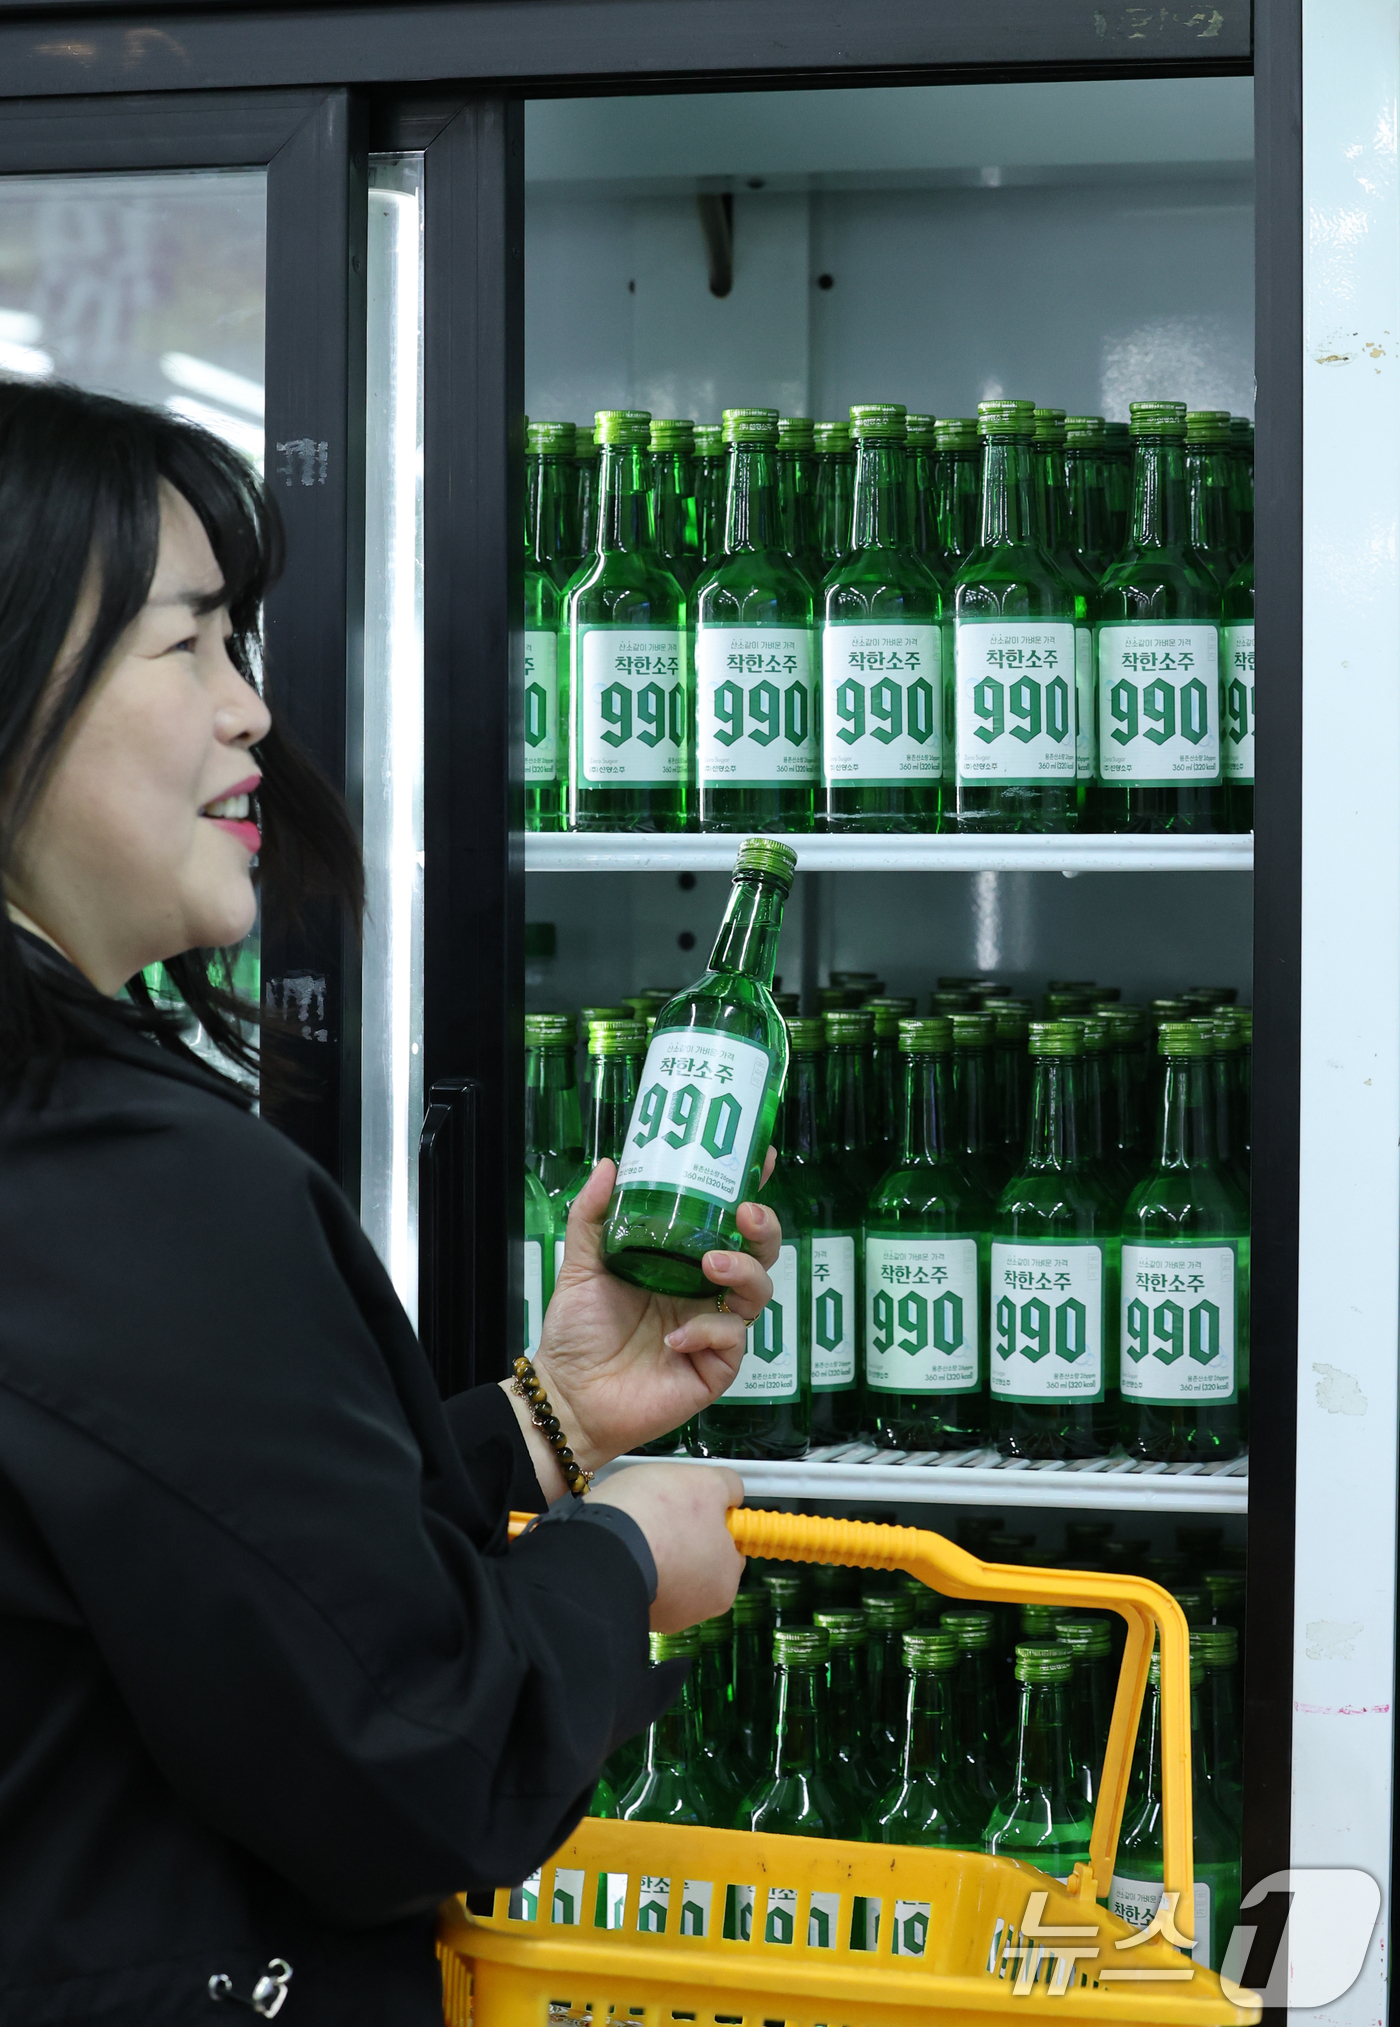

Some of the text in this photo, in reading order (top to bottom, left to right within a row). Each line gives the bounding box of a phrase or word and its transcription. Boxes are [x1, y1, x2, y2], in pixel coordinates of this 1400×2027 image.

[731, 639, 759, 650] 산소같이
[761, 641, 781, 649] 가벼운
[852, 636, 880, 647] 산소같이
[882, 638, 903, 646] 가벼운
[989, 634, 1018, 645] 산소같이
[1020, 636, 1042, 644] 가벼운
[1125, 637, 1152, 648] 산소같이
[1154, 638, 1176, 647] 가벼운
[614, 656, 679, 675] 착한소주
[727, 654, 798, 674] 착한소주
[848, 651, 921, 671] 착한소주
[986, 649, 1058, 669] 착한소주
[1122, 652, 1195, 672] 착한소주
[600, 681, 685, 748] 990
[713, 679, 808, 747] 990
[836, 676, 933, 745] 990
[973, 675, 1069, 744] 990
[1111, 677, 1208, 746] 990
[659, 1057, 734, 1084] 착한소주
[632, 1082, 742, 1159] 990
[683, 1170, 697, 1180] 360
[706, 1176, 721, 1188] (320
[721, 1183, 735, 1195] kcal)
[880, 1264, 949, 1284] 착한소주
[1004, 1270, 1072, 1291] 착한소주
[1136, 1272, 1205, 1293] 착한소주
[872, 1289, 963, 1356] 990
[996, 1295, 1086, 1363] 990
[1126, 1297, 1220, 1366] 990
[766, 1381, 780, 1389] (320
[1068, 1381, 1082, 1389] (320
[1201, 1383, 1216, 1391] (320
[1114, 1902, 1156, 1926] 착한소
